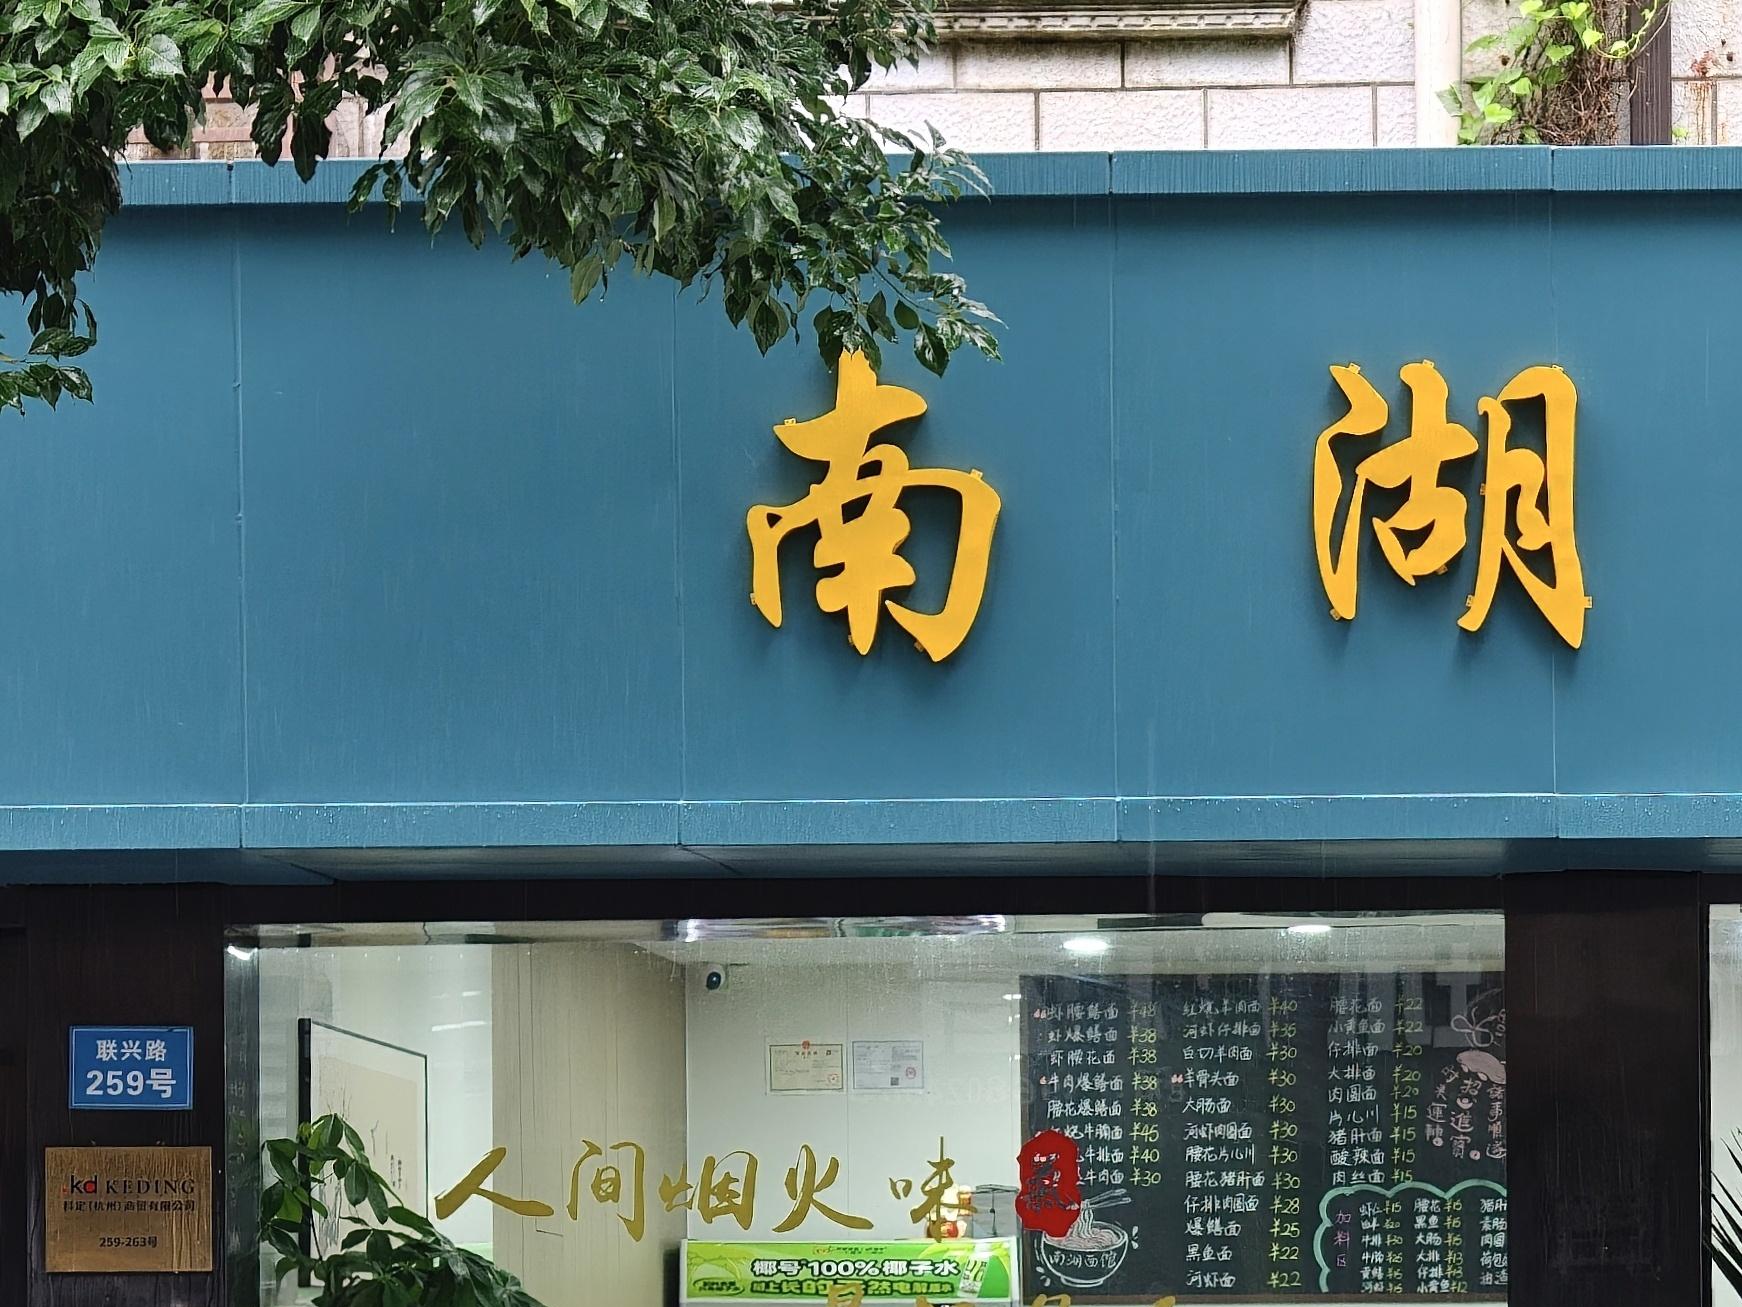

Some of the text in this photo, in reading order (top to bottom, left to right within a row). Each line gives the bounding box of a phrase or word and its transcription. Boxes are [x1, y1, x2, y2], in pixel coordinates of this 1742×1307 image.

[1269, 997, 1298, 1015] ¥40
[1128, 1026, 1157, 1043] ¥38
[1269, 1021, 1296, 1038] ¥35
[1328, 1017, 1423, 1034] 小黄鱼面 ¥22
[96, 1040, 167, 1062] 联兴路
[1128, 1047, 1157, 1065] ¥38
[1266, 1042, 1297, 1061] ¥30
[1328, 1038, 1422, 1059] 仔排面 ¥20
[1131, 1072, 1158, 1090] ¥38
[1184, 1067, 1296, 1088] 羊骨头面 ¥30
[1328, 1063, 1421, 1083] 大排面 ¥20
[86, 1068, 176, 1098] 259号
[1390, 1085, 1419, 1100] ¥20
[1130, 1098, 1158, 1117] ¥38
[1182, 1094, 1296, 1115] 大肠面 ¥30
[1390, 1103, 1417, 1123] ¥15
[1051, 1122, 1159, 1142] 烧牛腩面 ¥45
[1269, 1120, 1298, 1140] ¥30
[1328, 1126, 1416, 1145] 猪肝面 ¥15
[1129, 1145, 1159, 1164] ¥40
[1268, 1145, 1298, 1165] ¥30
[1331, 1146, 1415, 1166] 酸辣面 ¥15
[105, 1179, 195, 1194] KEDING
[1129, 1168, 1161, 1186] ¥30
[1272, 1172, 1300, 1190] ¥30
[1333, 1169, 1413, 1185] 肉丝面 ¥15
[435, 1136, 978, 1243] 人间烟火味
[1270, 1195, 1300, 1214] ¥28
[1269, 1218, 1300, 1237] ¥25
[99, 1236, 158, 1248] 259-263号
[1186, 1242, 1299, 1262] 黑鱼面 ¥22
[1444, 1250, 1463, 1265] ¥13
[1186, 1270, 1301, 1288] 河虾面 ¥22
[1450, 1281, 1468, 1293] ¥12
